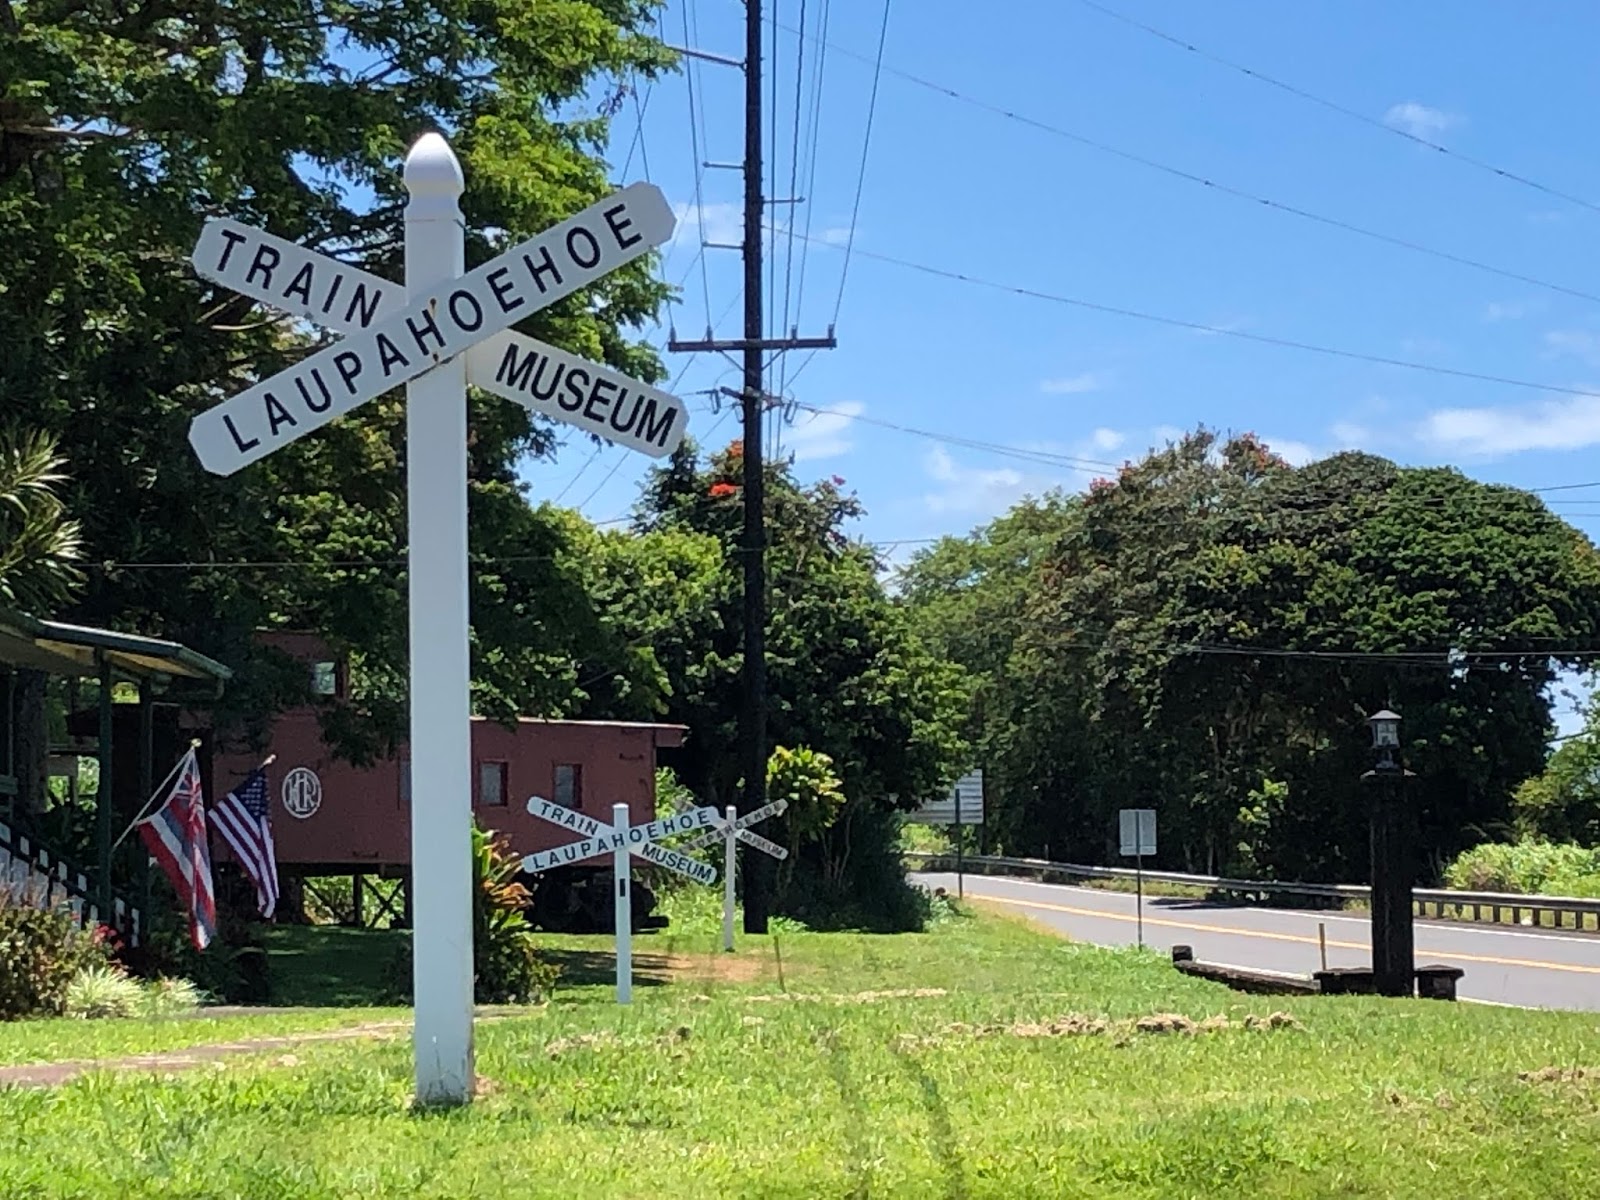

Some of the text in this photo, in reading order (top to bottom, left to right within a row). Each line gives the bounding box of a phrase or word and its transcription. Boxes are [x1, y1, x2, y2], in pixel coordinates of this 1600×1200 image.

[220, 230, 382, 328] TRAIN
[223, 204, 643, 454] LAUPAHOEHOE
[496, 343, 677, 449] MUSEUM
[533, 810, 710, 869] LAUPAHOEHOE
[540, 802, 598, 835] TRAIN
[641, 843, 712, 882] MUSEUM
